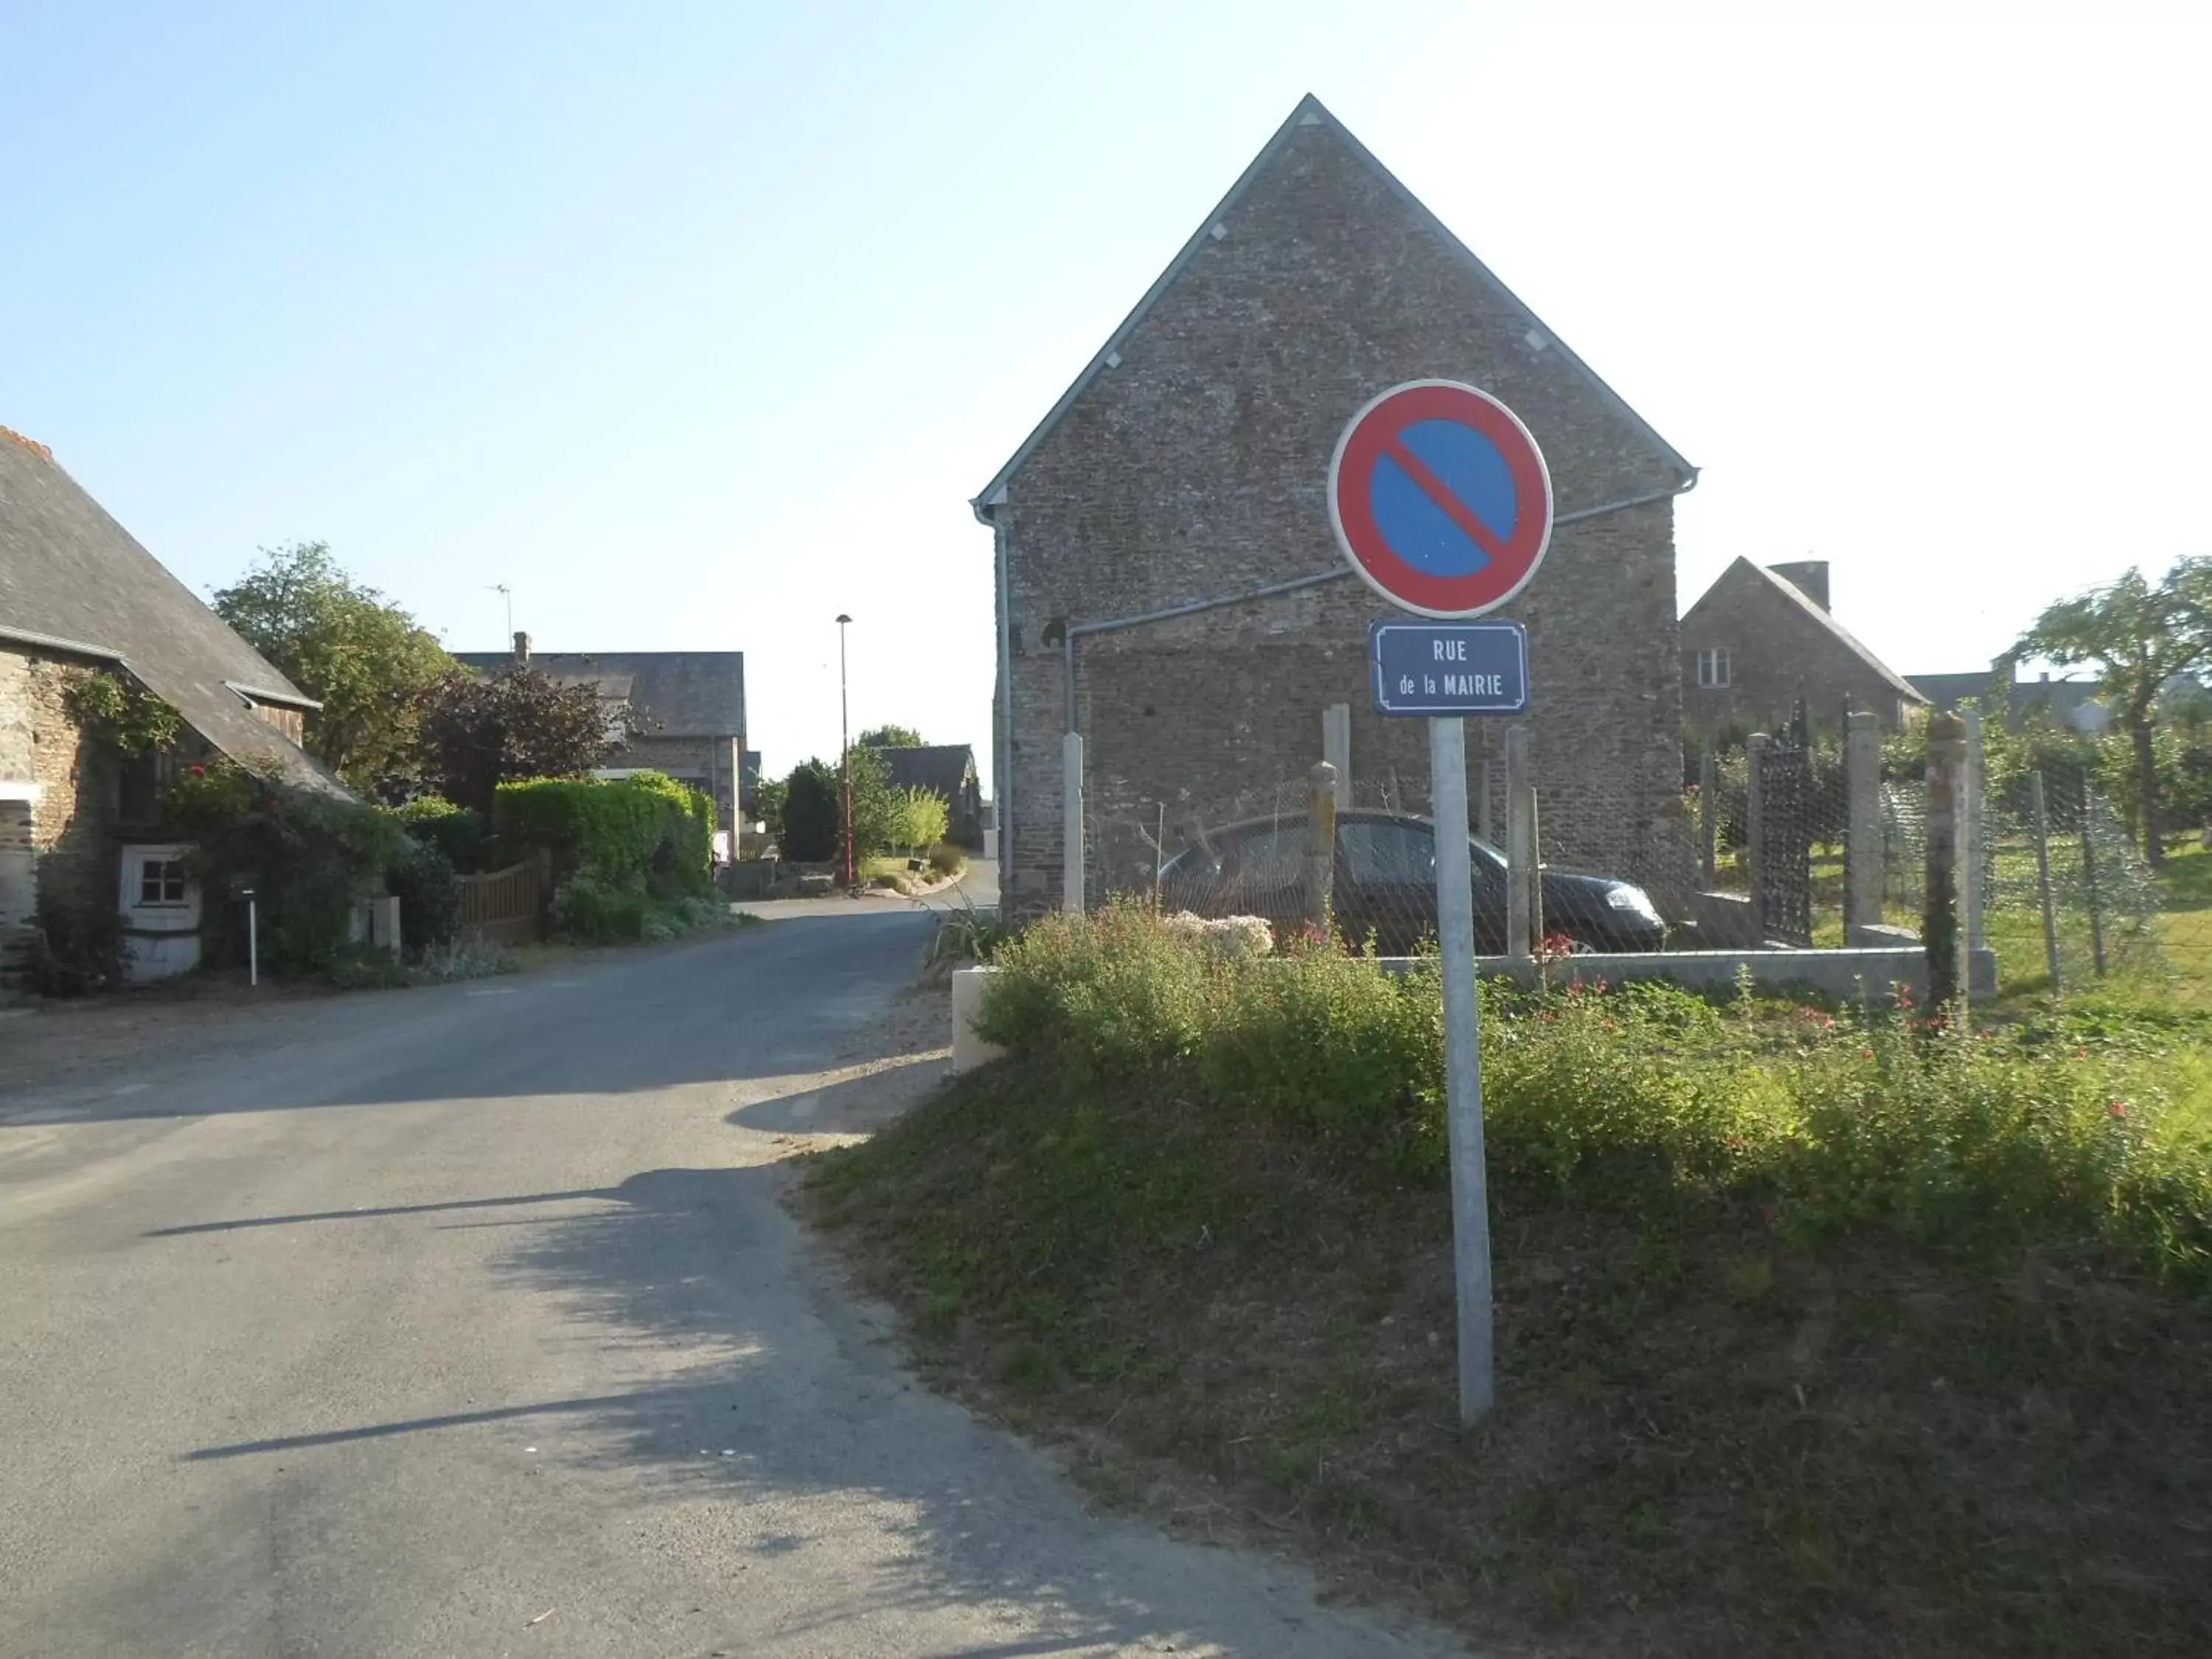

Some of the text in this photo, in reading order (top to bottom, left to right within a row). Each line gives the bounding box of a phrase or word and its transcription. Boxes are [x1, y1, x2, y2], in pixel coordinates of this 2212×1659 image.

[1433, 640, 1467, 661] RUE
[1400, 675, 1503, 695] de la MAIRIE
